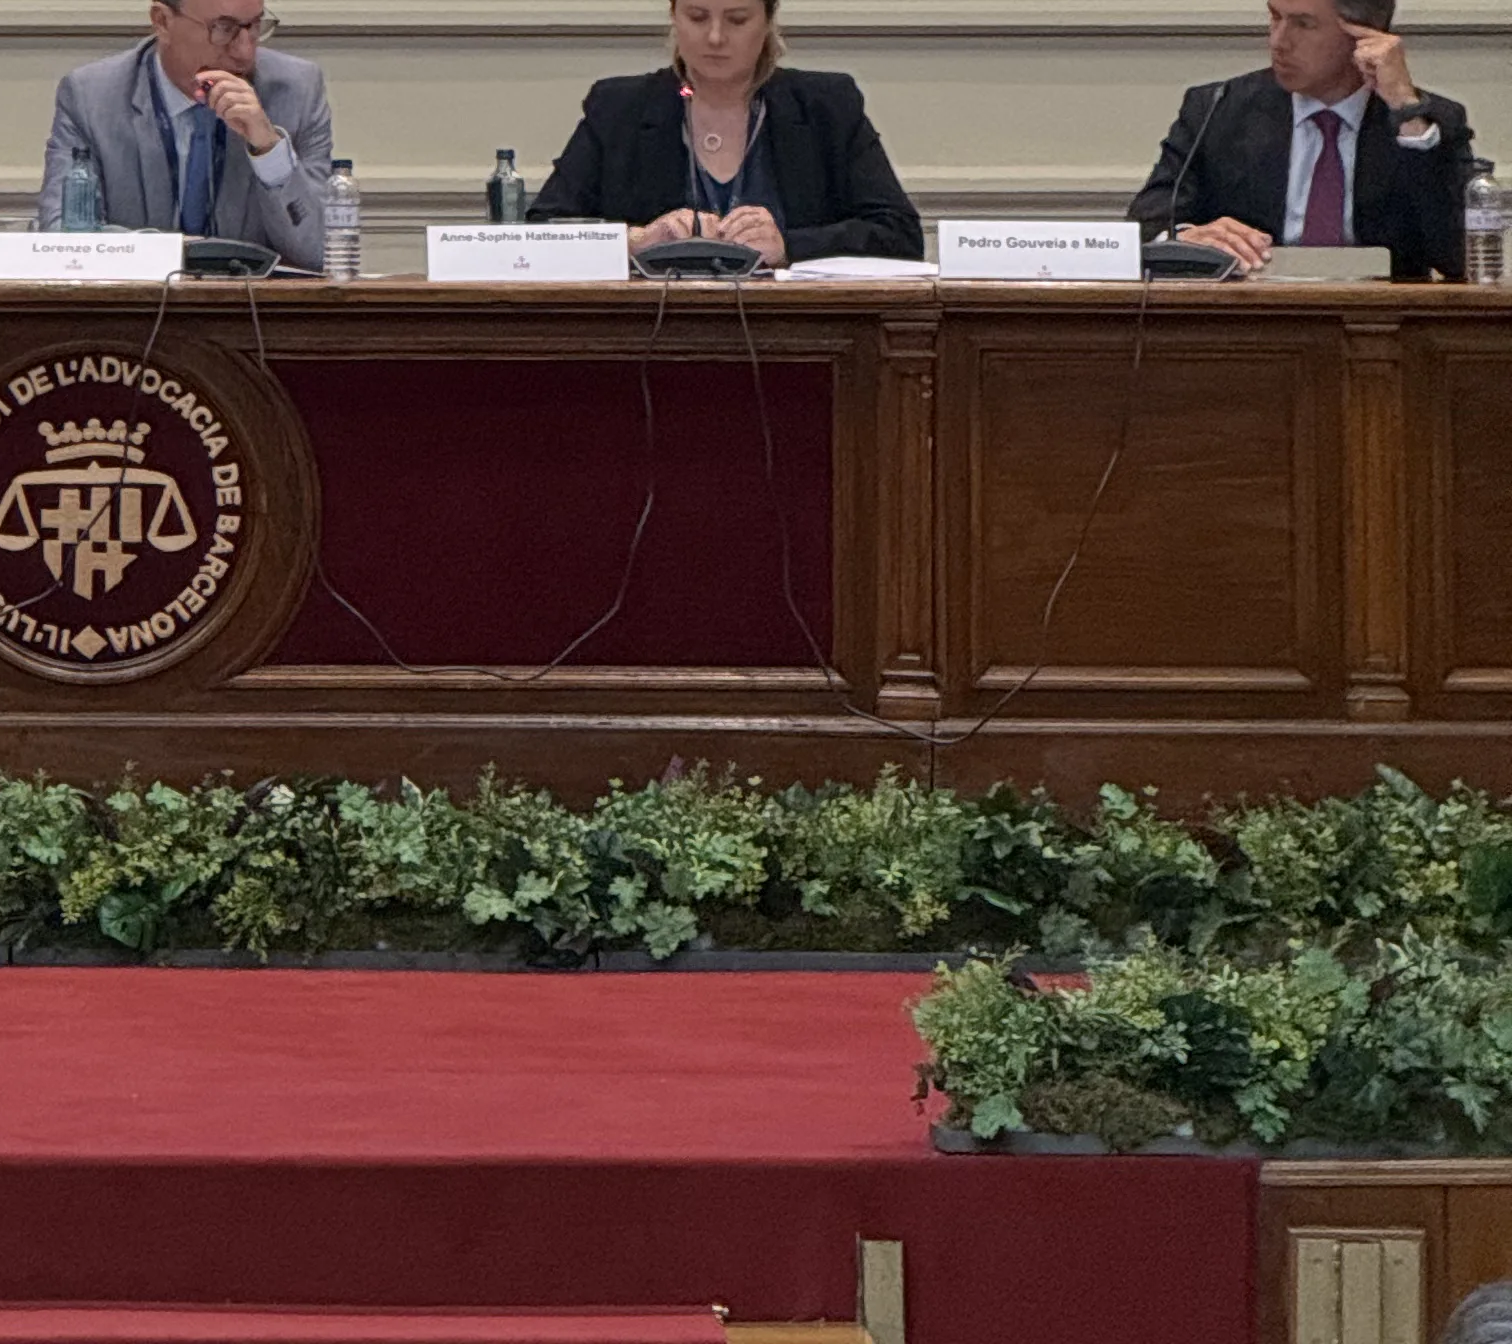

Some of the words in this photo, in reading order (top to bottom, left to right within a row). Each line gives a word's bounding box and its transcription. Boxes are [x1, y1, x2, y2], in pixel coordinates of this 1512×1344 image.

[32, 243, 92, 254] Lorenzo
[95, 243, 136, 254] Conti
[440, 231, 522, 244] Anne-Sophie
[525, 231, 621, 242] Hatteau-Hiltzer
[958, 236, 1002, 249] Pedro
[1006, 236, 1067, 249] Gouveia
[1070, 240, 1080, 249] e
[1084, 238, 1120, 250] Melo
[7, 365, 55, 406] DE
[211, 463, 243, 507] DE
[104, 514, 242, 654] BARCELONA
